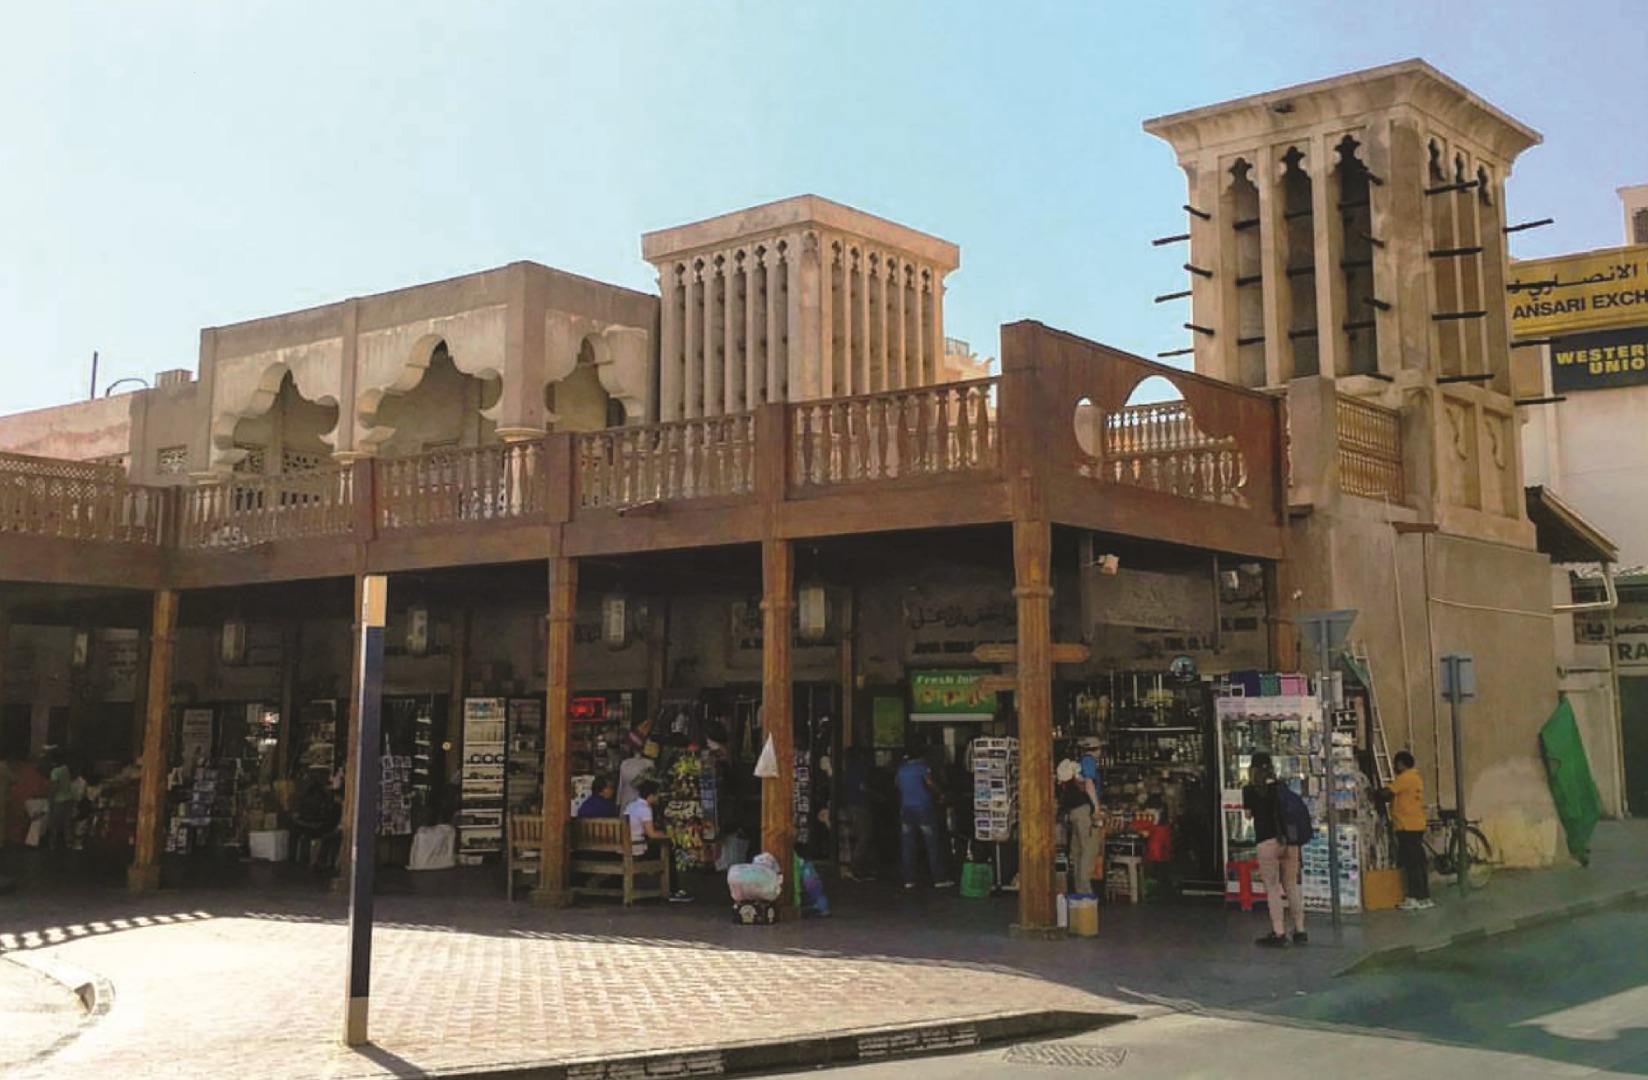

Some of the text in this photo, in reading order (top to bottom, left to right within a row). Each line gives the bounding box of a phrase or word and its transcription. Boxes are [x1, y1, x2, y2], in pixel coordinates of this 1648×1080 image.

[1513, 288, 1648, 319] ANSARI EXCH
[1556, 343, 1648, 366] WESTER
